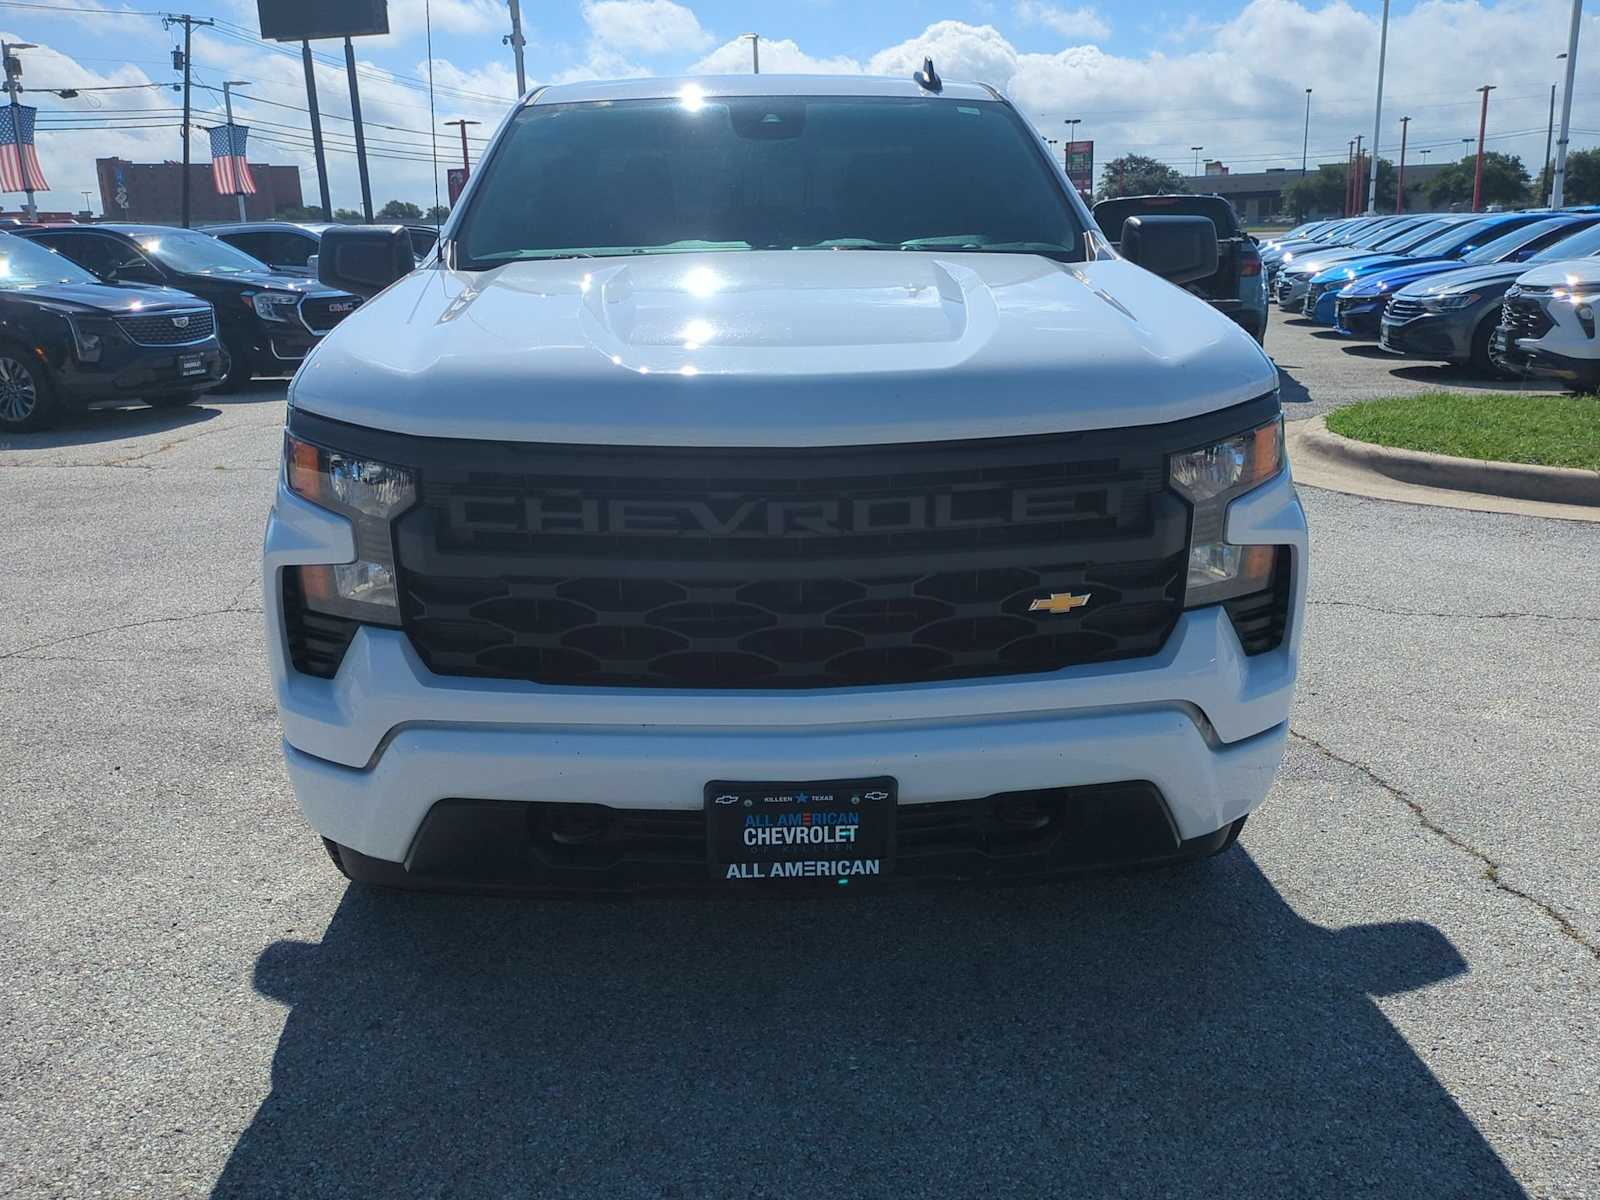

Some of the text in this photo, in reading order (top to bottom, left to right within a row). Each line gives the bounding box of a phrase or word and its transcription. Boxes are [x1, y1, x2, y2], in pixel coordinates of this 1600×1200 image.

[329, 302, 354, 312] GMC
[449, 484, 1124, 538] CHEVROLET
[745, 812, 859, 827] ALL AMERICAN
[743, 825, 859, 846] CHEVROLET
[726, 859, 880, 879] ALL AMERICAN
